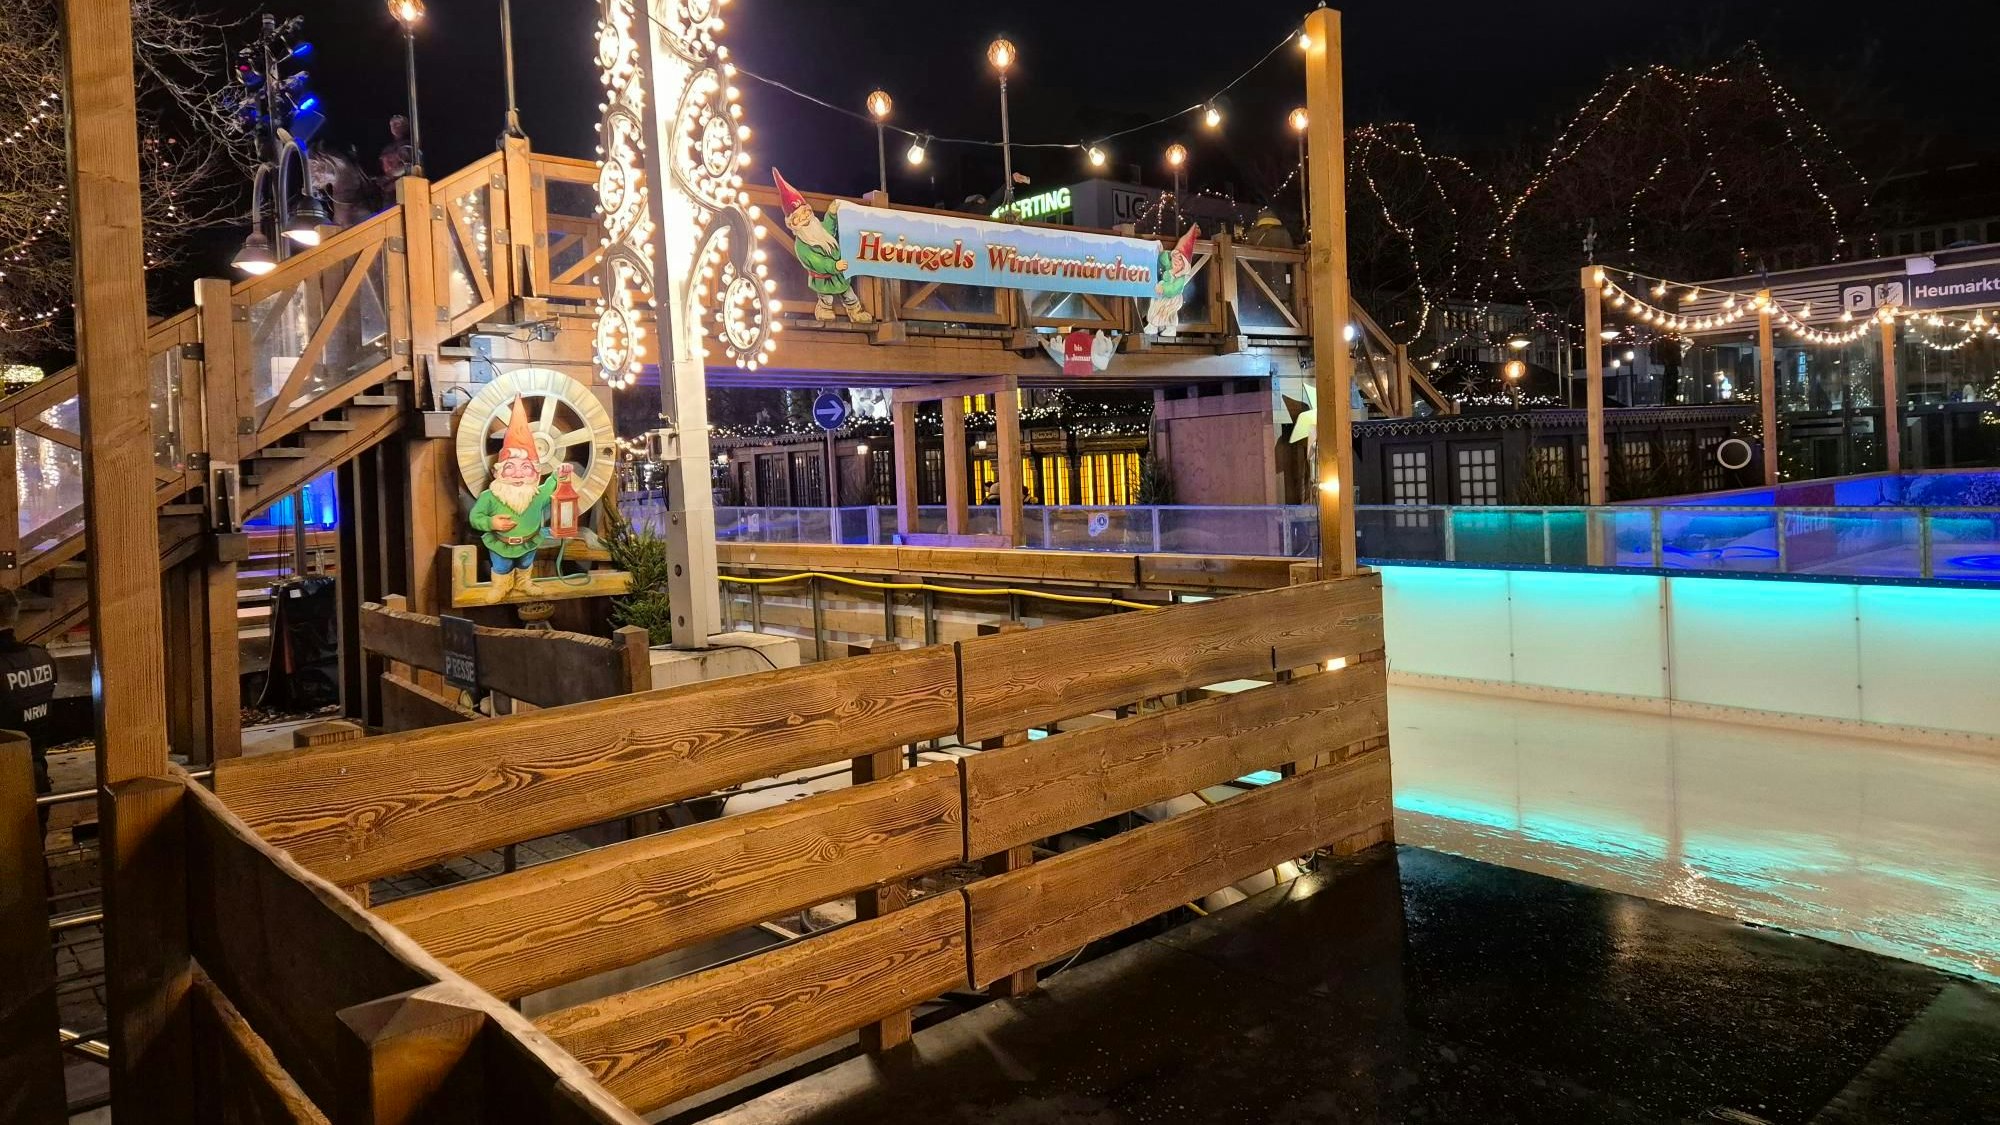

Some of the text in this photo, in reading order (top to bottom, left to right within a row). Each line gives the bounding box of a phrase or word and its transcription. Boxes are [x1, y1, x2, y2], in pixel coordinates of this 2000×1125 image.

[856, 230, 1152, 284] Heinzels Wintermärchen
[1915, 277, 2000, 299] Heumarkt
[6, 664, 53, 690] POLIZEI
[23, 702, 48, 722] NRW
